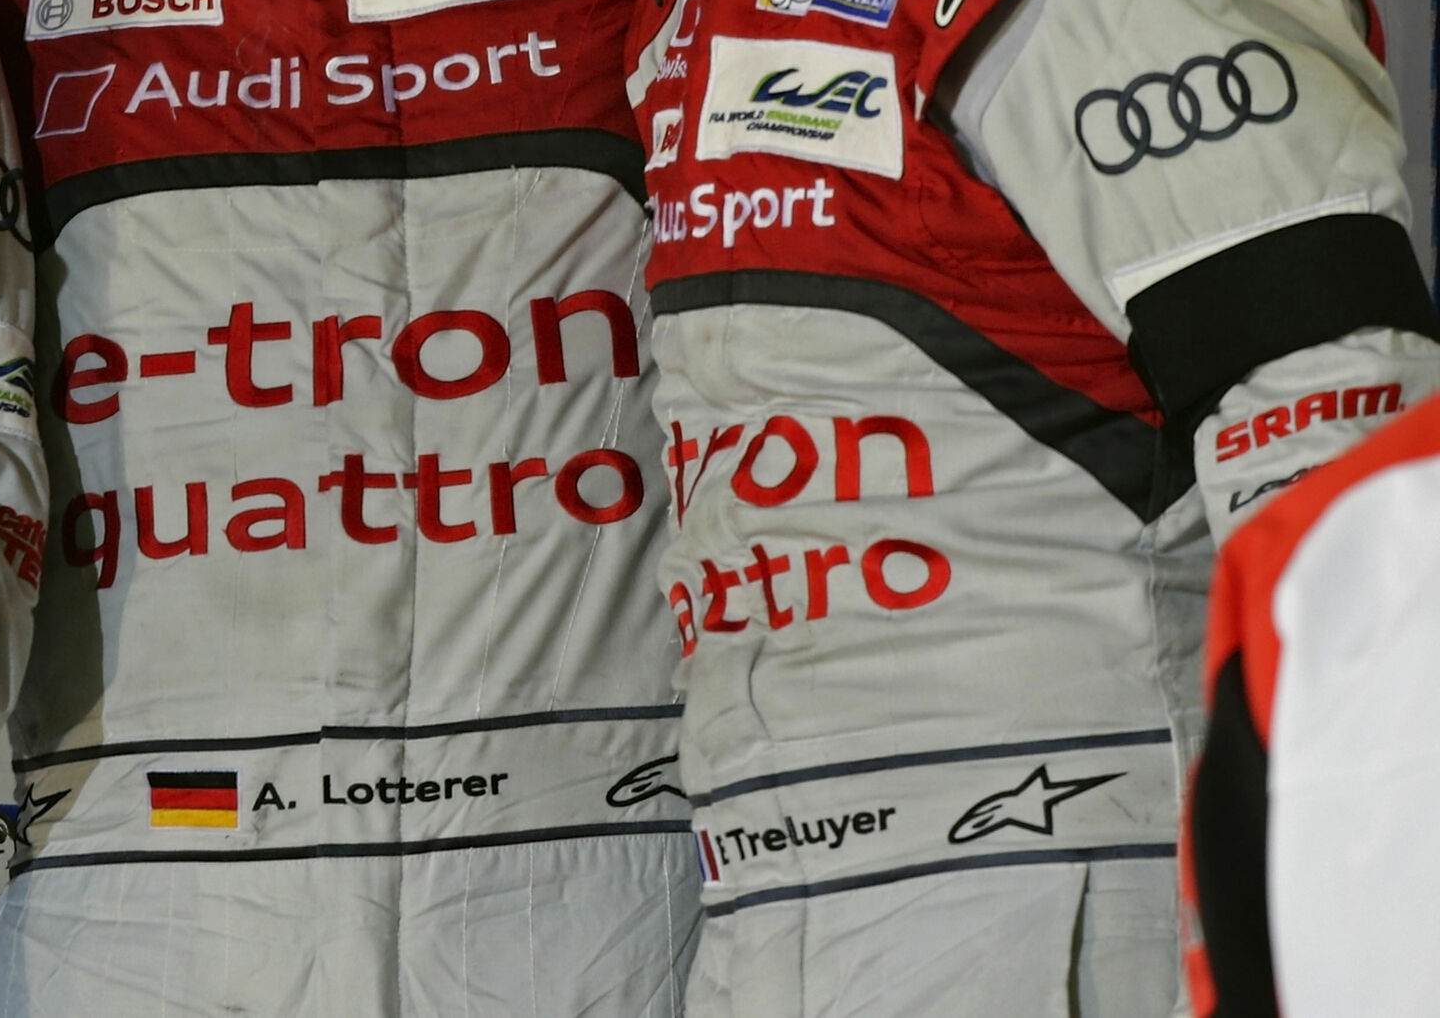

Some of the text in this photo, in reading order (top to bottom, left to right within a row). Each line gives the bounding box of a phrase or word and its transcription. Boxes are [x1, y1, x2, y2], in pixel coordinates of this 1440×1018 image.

[124, 32, 561, 115] Audi Sport
[749, 67, 888, 119] WEC
[690, 178, 836, 249] Sport
[50, 289, 640, 425] e-tron
[1216, 382, 1402, 464] SRAM
[668, 415, 935, 528] tron
[61, 448, 645, 590] quattro
[669, 537, 952, 659] attro
[252, 773, 509, 812] A. Lotterer
[726, 807, 897, 862] Treluyer
